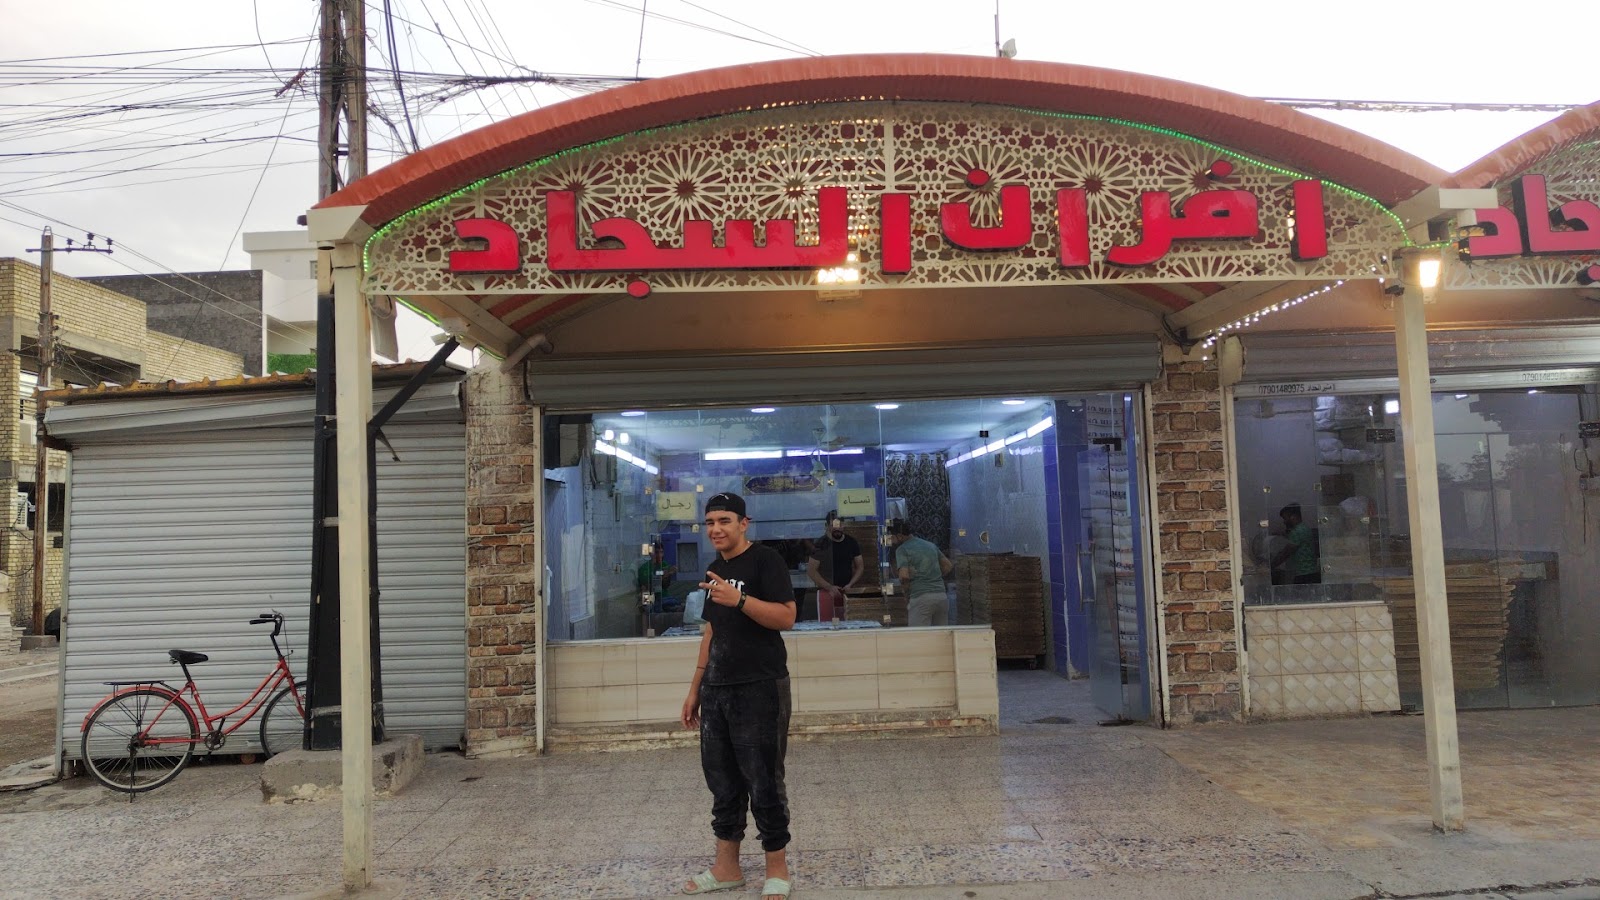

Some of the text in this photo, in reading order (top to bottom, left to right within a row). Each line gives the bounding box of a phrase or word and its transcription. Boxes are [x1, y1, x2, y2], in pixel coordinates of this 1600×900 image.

[448, 159, 1329, 298] افران السجاد
[661, 498, 692, 510] رجال
[842, 495, 872, 506] نساء
